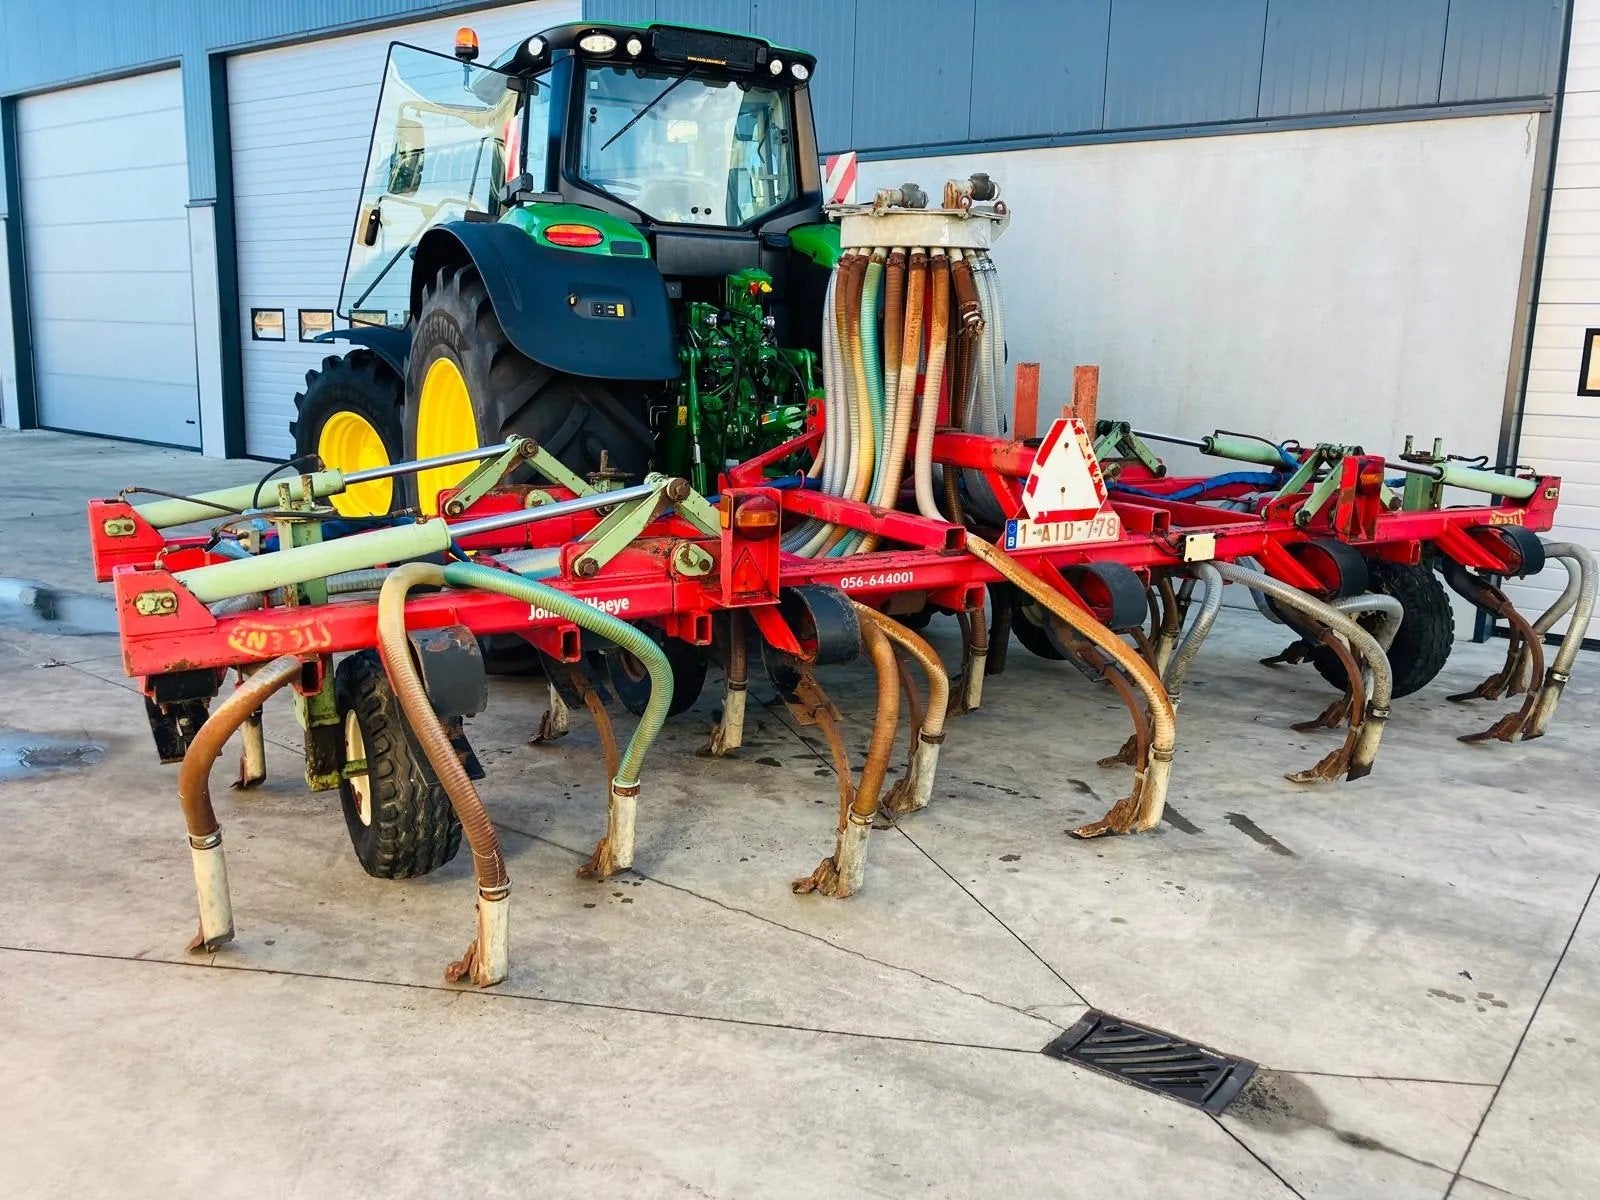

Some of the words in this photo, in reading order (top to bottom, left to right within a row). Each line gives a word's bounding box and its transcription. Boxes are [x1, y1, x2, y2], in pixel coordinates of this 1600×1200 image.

[1007, 537, 1015, 547] B
[840, 571, 914, 589] 056-644001
[579, 596, 630, 615] 'Haeye
